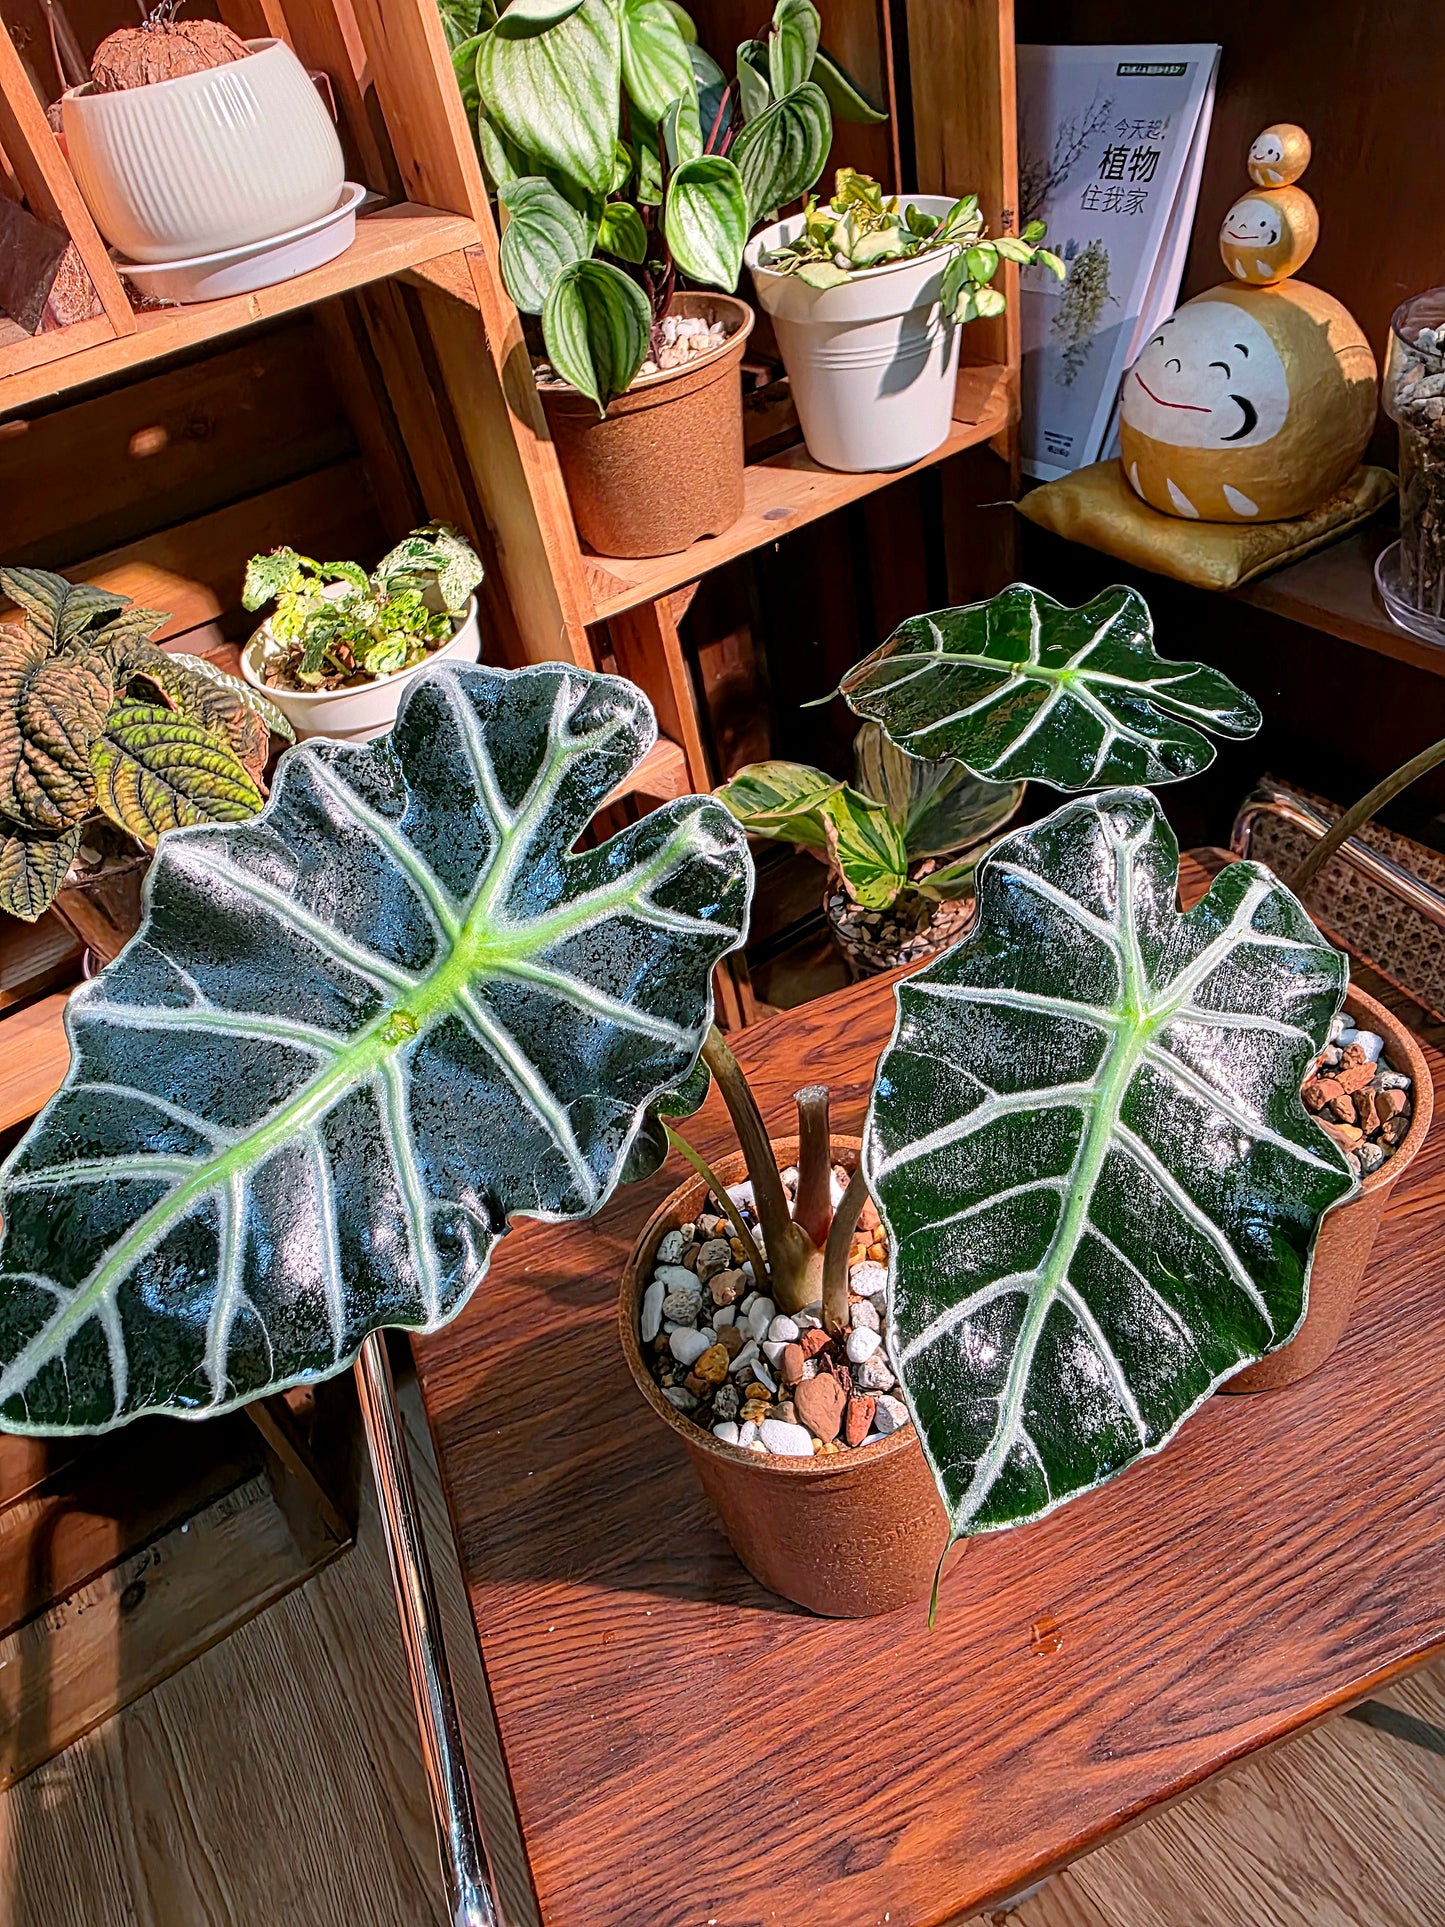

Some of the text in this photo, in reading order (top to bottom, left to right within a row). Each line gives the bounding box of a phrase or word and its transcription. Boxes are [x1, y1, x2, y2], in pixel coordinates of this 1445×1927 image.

[1098, 143, 1161, 183] 植物
[1080, 183, 1149, 216] 住我家
